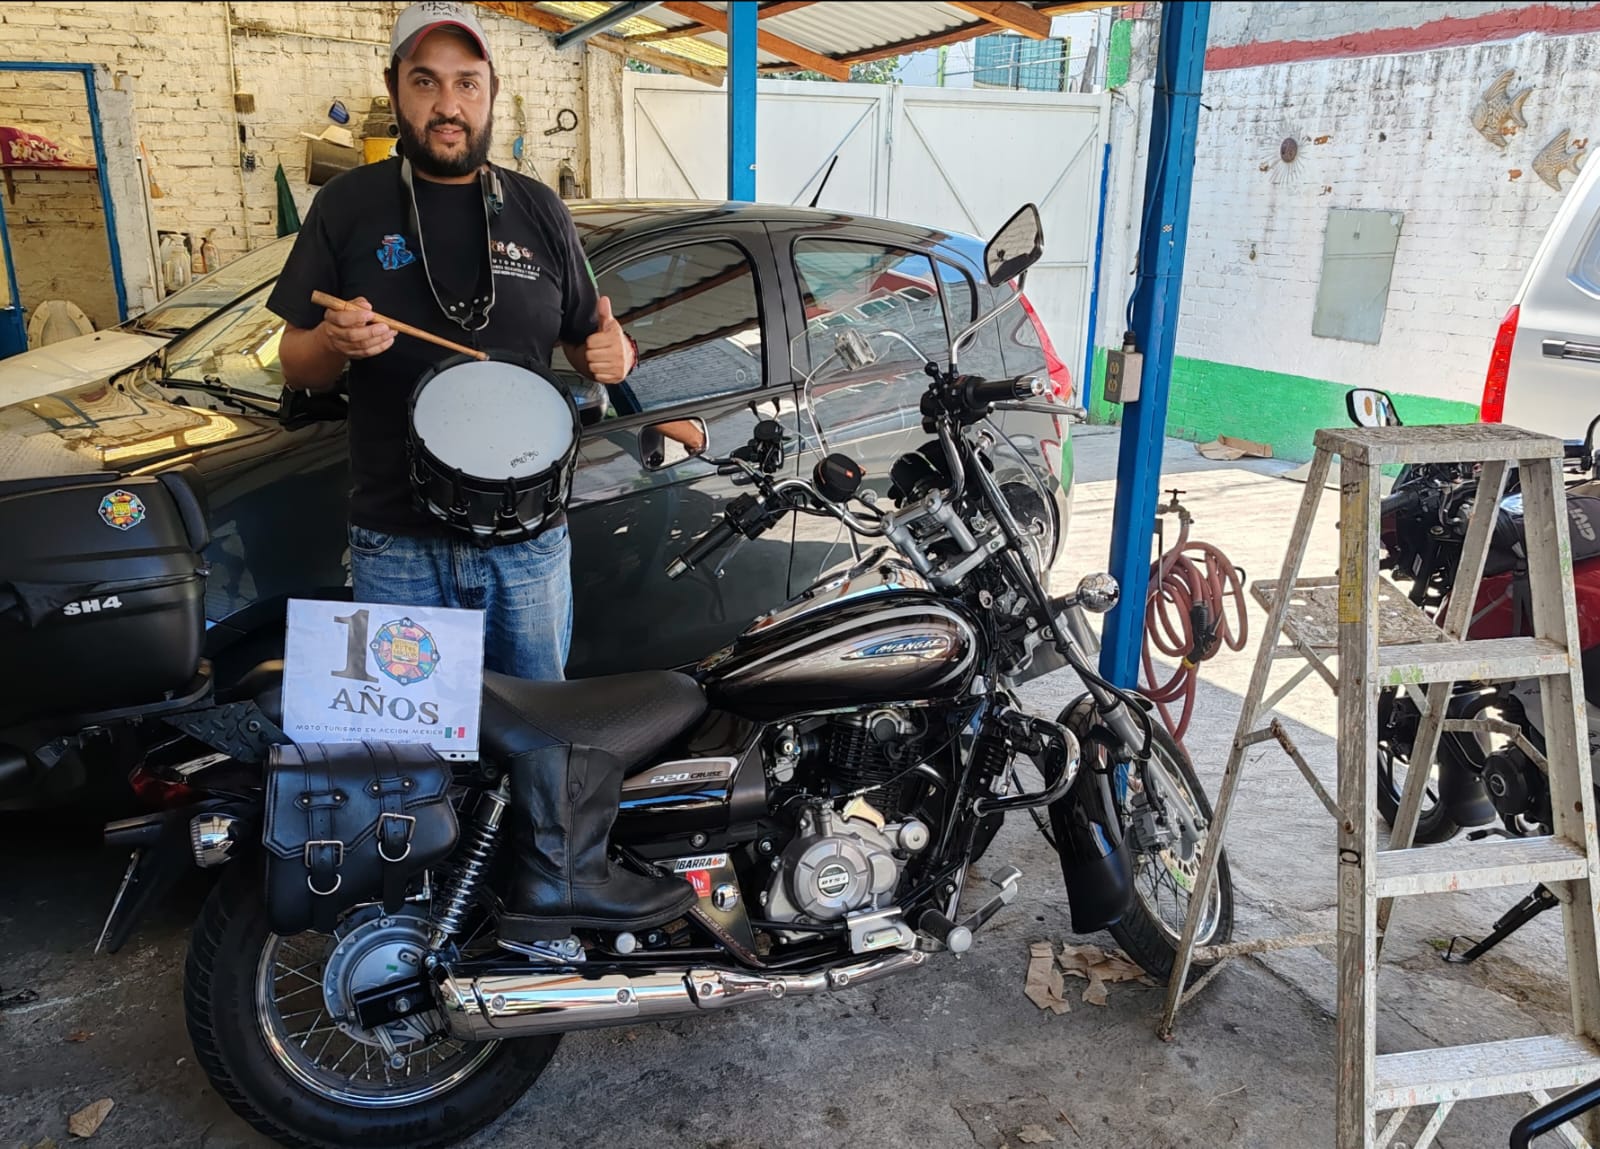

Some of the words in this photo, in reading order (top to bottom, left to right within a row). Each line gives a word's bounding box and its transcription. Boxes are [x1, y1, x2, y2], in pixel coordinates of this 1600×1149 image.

[491, 259, 540, 272] UTOMOTRIZ
[63, 595, 123, 616] SH4
[875, 639, 940, 654] AVENGER
[328, 685, 439, 725] AÑOS
[324, 725, 362, 733] TURISMO
[650, 772, 690, 784] 220
[690, 770, 723, 778] CRUISE
[675, 857, 712, 870] IBARRA
